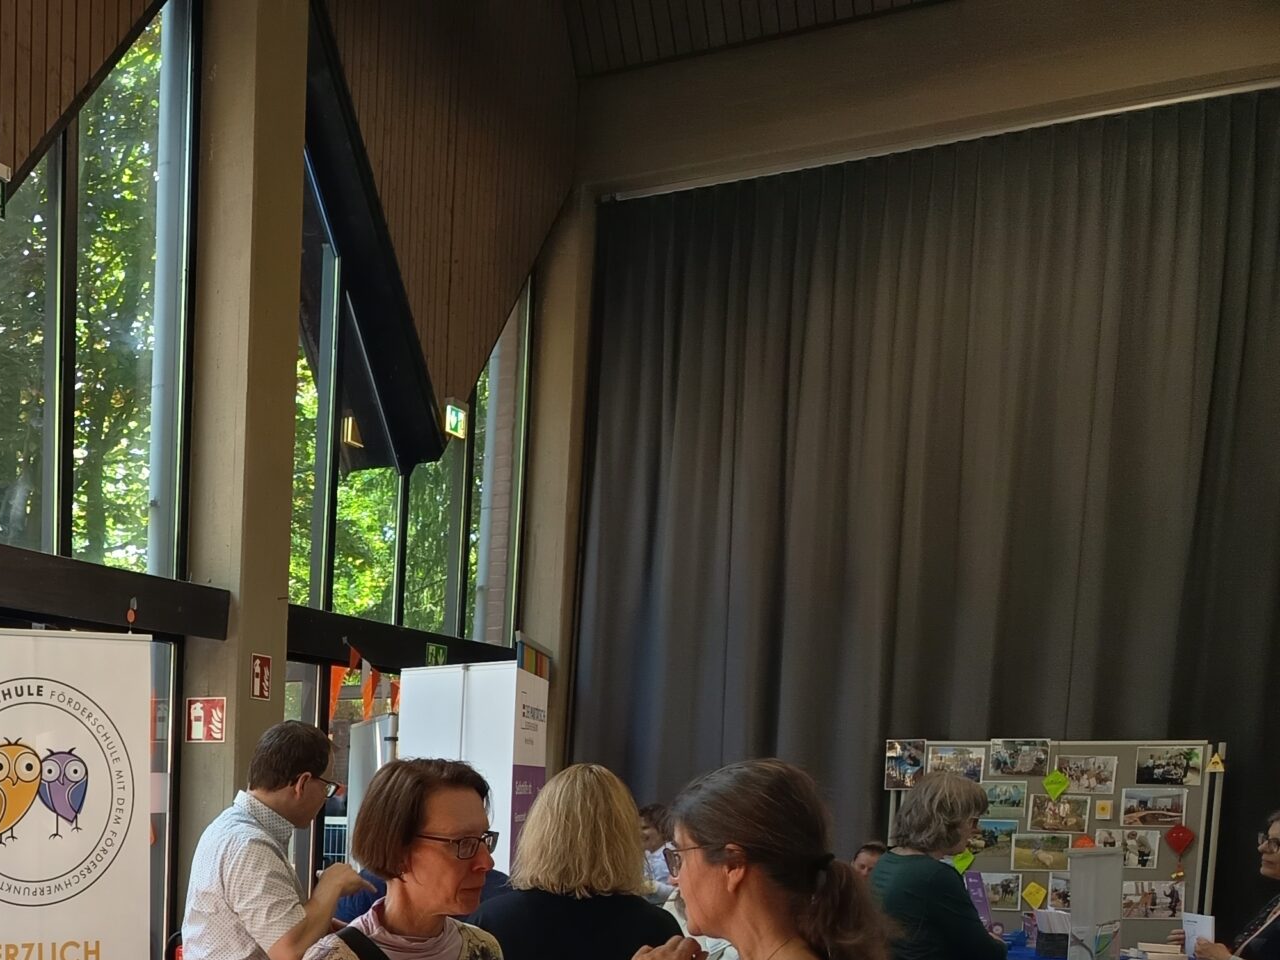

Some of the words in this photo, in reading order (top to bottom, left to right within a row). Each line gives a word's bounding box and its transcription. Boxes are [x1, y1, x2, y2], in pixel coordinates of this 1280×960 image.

[50, 690, 121, 765] FÖRDERSCHULE
[114, 769, 126, 792] MIT
[112, 797, 126, 825] DEM
[0, 830, 118, 897] FÖRDERSCHWERPUNKT
